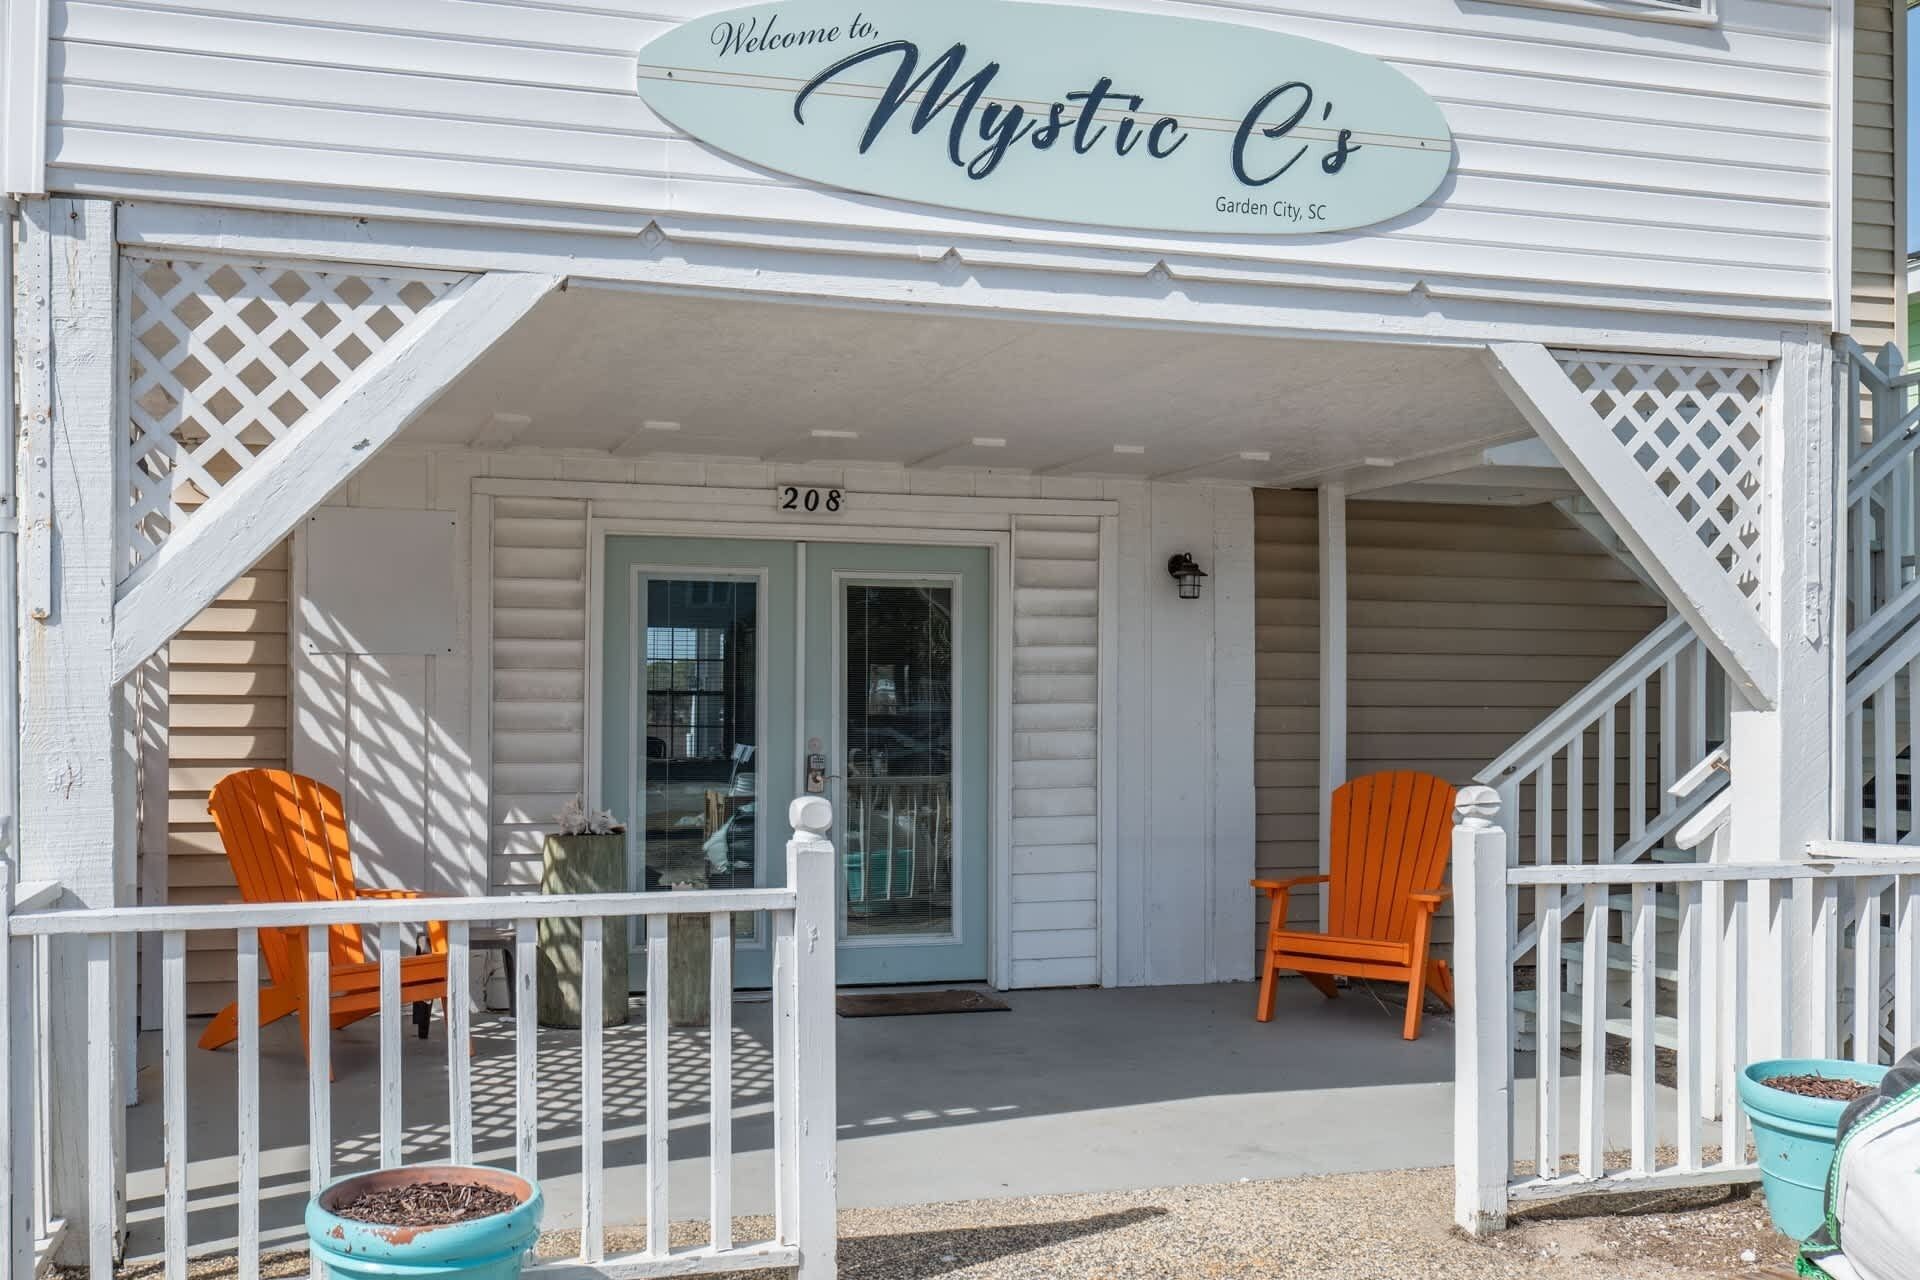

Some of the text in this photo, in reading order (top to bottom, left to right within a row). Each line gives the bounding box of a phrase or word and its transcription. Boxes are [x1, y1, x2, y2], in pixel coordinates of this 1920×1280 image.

[710, 12, 880, 57] Welcome to,
[793, 39, 1362, 186] Mystic C's
[1215, 196, 1327, 222] Garden City, SC
[782, 487, 841, 511] 208
